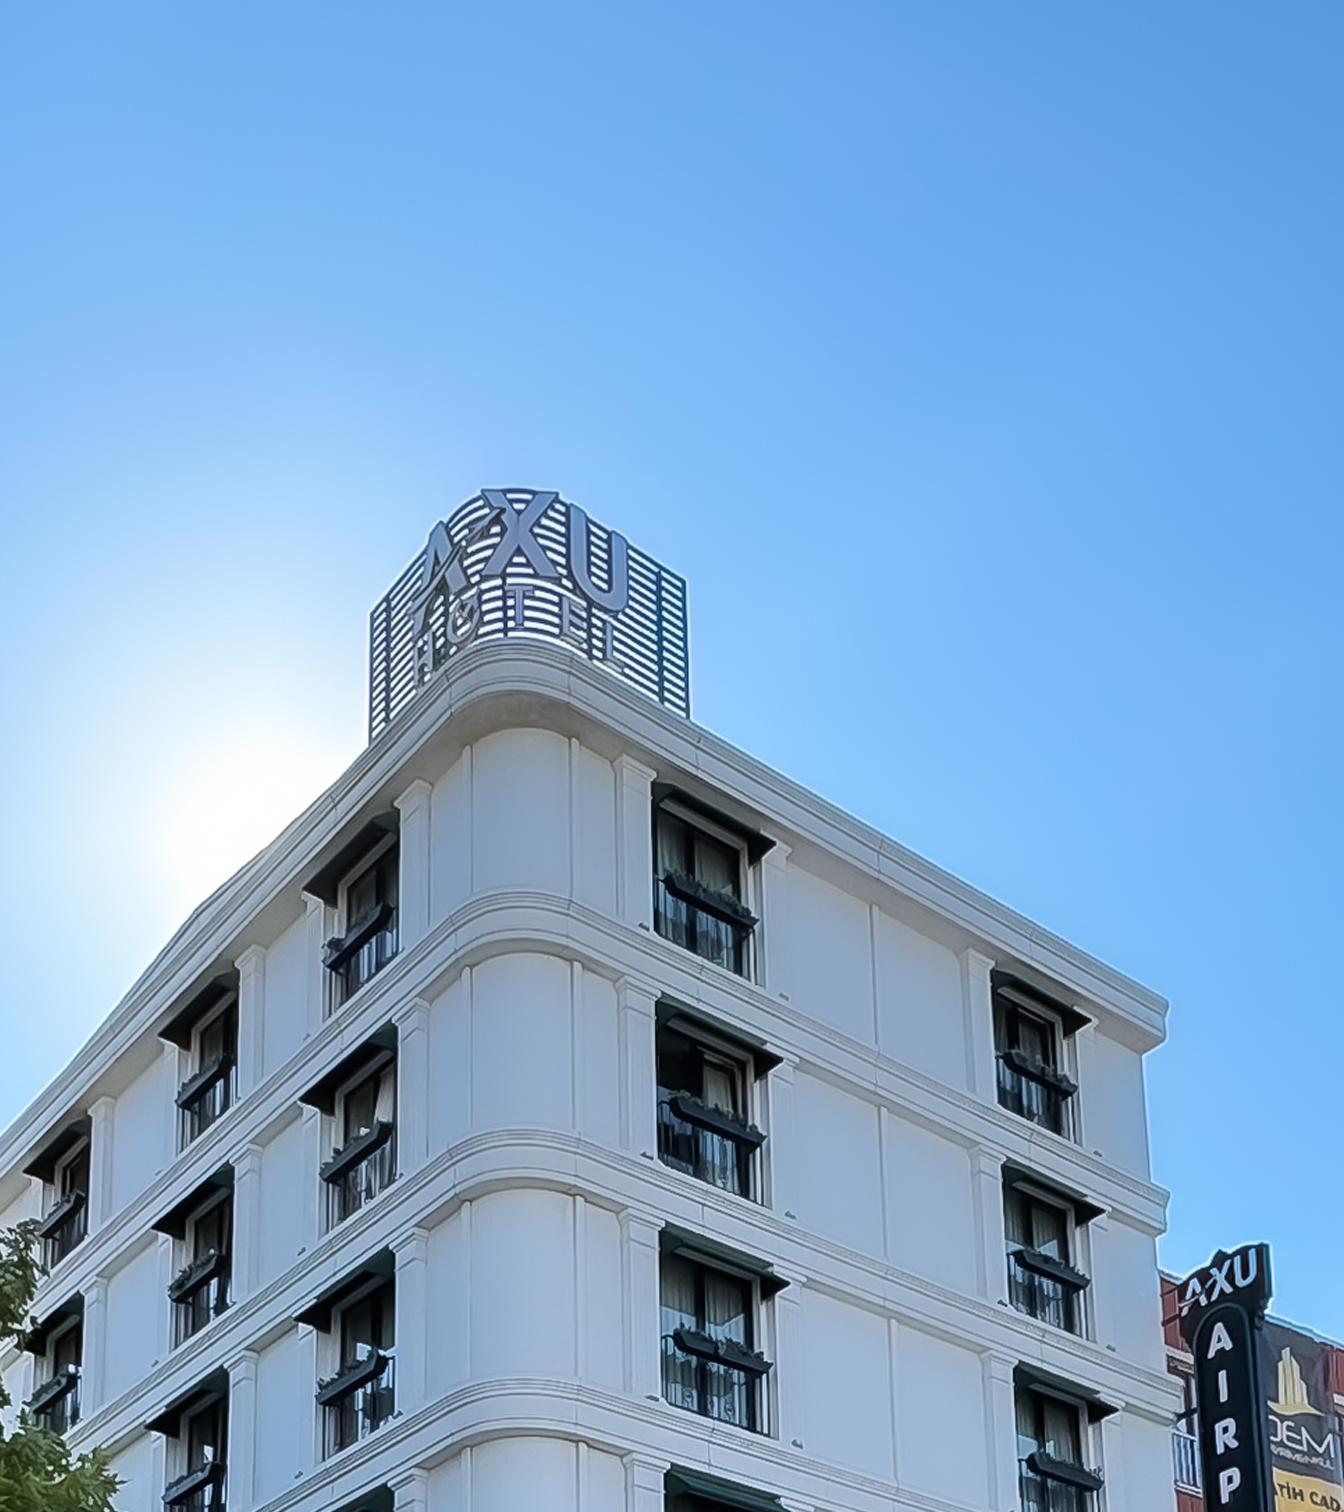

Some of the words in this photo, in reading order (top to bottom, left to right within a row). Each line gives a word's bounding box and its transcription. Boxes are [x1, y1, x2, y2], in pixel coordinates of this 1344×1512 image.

[408, 488, 629, 636] AXU
[412, 585, 625, 690] HOTEL
[1178, 1248, 1257, 1317] AXU
